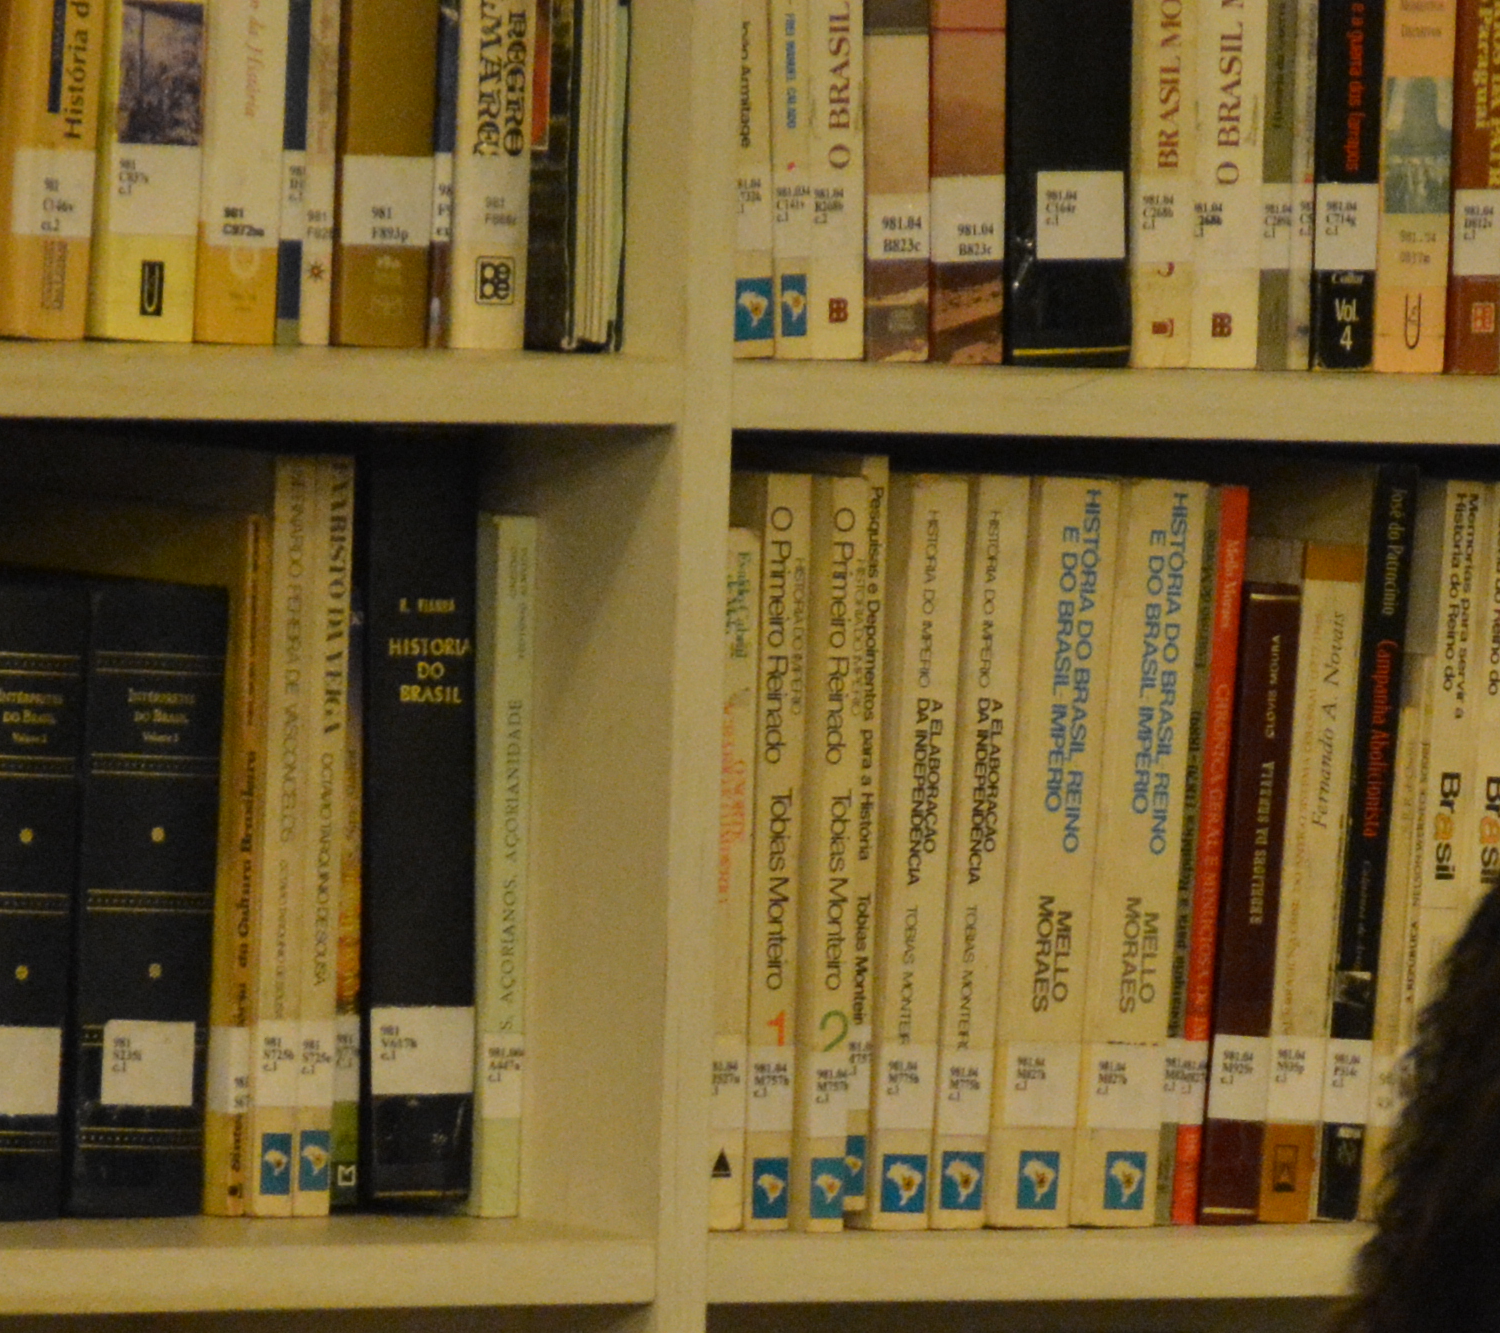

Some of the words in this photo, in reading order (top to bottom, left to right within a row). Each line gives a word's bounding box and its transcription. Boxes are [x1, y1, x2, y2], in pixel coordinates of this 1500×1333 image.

[64, 24, 89, 139] História
[739, 65, 752, 148] Armitage
[828, 0, 851, 131] BRASIL
[1218, 24, 1244, 148] BRASIL
[1475, 10, 1492, 130] Paraguai
[828, 144, 851, 169] O
[1216, 162, 1240, 186] O
[882, 215, 923, 231] 981.04
[883, 236, 922, 253] B823c
[957, 224, 994, 238] 981.04
[1339, 325, 1353, 352] 4
[769, 506, 793, 533] O
[832, 506, 856, 533] O
[1062, 526, 1081, 543] E
[1385, 521, 1405, 540] do
[1386, 488, 1408, 520] José
[1059, 551, 1079, 593] DO
[1078, 488, 1102, 613] HISTÓRIA
[1165, 490, 1189, 616] HISTÓRIA
[1379, 544, 1403, 616] Patrocínio
[767, 540, 792, 650] Primeiro
[829, 541, 853, 650] Primeiro
[388, 638, 470, 657] HISTORIA
[416, 661, 445, 680] DO
[1051, 598, 1075, 696] BRASIL
[1075, 619, 1094, 661] DO
[1161, 621, 1182, 664] DO
[1369, 639, 1399, 726] Campanha
[399, 683, 463, 704] BRASIL
[764, 654, 790, 765] Reinado
[825, 655, 850, 765] Reinado
[916, 697, 930, 724] DA
[977, 697, 991, 724] DA
[1068, 666, 1091, 762] BRASIL
[1154, 668, 1178, 758] BRASIL
[278, 702, 300, 843] VASCONCELOS
[500, 699, 524, 863] AÇORIANIDADE
[1044, 702, 1071, 813] IMPÉRIO
[1361, 730, 1393, 839] Abolicionista
[766, 788, 794, 874] Tobias
[828, 788, 854, 874] Tobias
[905, 728, 930, 887] INDEPENDÊNCIA
[966, 728, 991, 885] INDEPENDÊNCIA
[1062, 769, 1085, 854] REINO
[1148, 771, 1171, 856] REINO
[1433, 771, 1463, 881] Brasil
[765, 876, 791, 991] Monteiro
[825, 876, 851, 991] Monteiro
[1031, 895, 1057, 1013] MORAES
[1051, 910, 1074, 1004] MELLO
